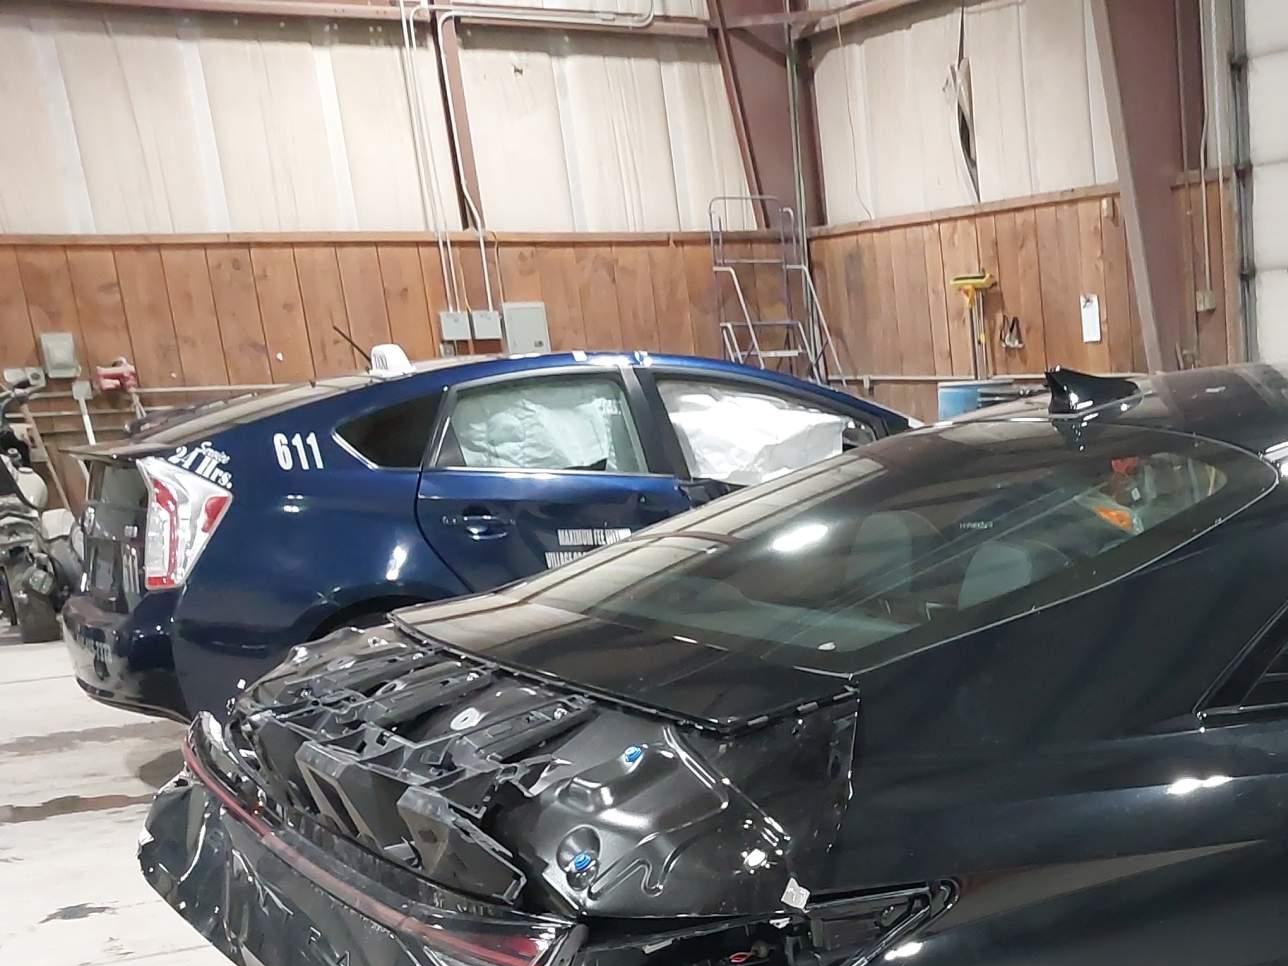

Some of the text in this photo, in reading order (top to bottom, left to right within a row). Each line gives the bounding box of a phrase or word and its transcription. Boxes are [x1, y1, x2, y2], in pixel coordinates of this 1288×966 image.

[168, 446, 233, 489] 24 Hrs.
[273, 432, 324, 470] 611
